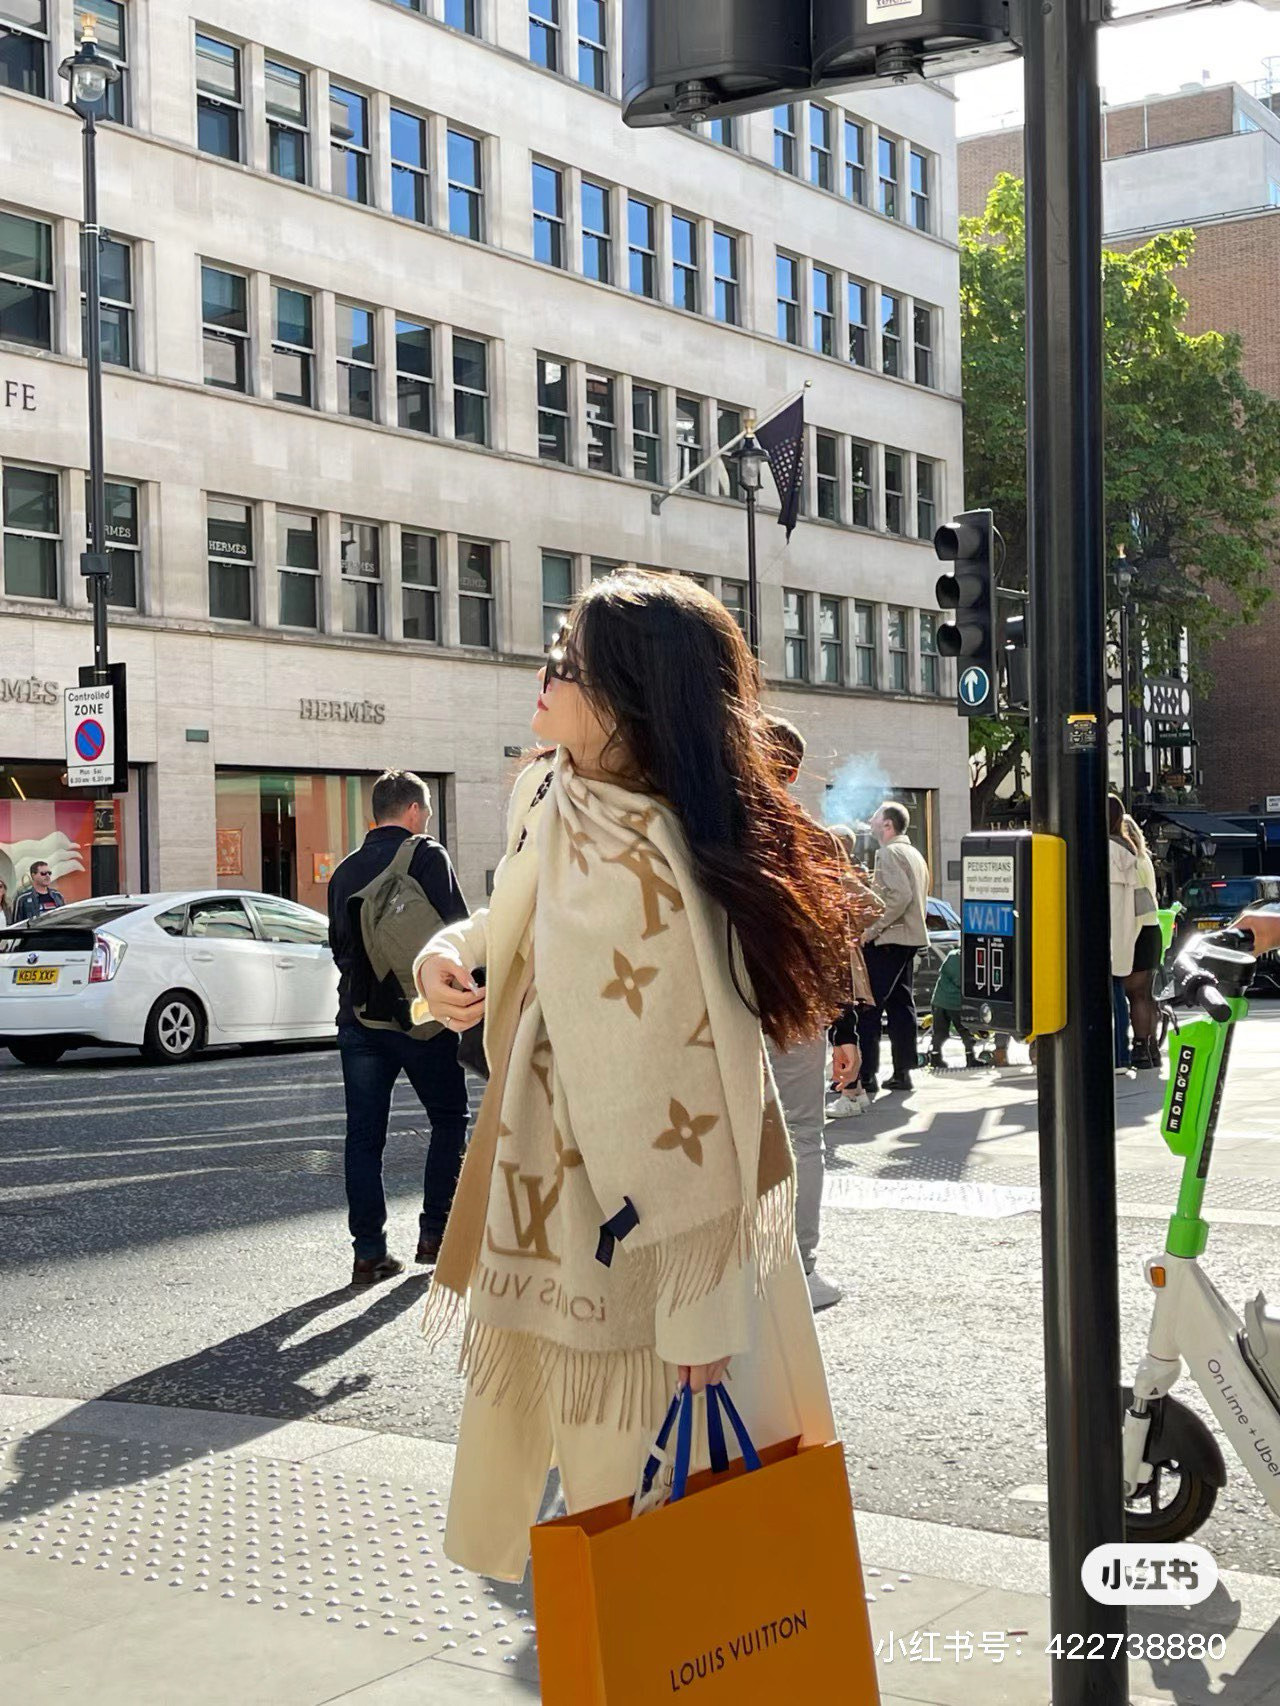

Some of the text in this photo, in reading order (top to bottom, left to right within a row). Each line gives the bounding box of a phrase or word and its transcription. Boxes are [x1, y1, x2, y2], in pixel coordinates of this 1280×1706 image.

[5, 380, 36, 411] FE
[68, 690, 110, 702] Controlled
[74, 703, 104, 716] ZONE
[299, 698, 386, 725] HERMÈS
[967, 861, 1012, 873] PEDESTRIANS
[968, 906, 1012, 932] WAIT
[1207, 1359, 1225, 1385] On
[1221, 1385, 1249, 1425] Lime
[670, 1608, 808, 1692] LOUIS VUITTON
